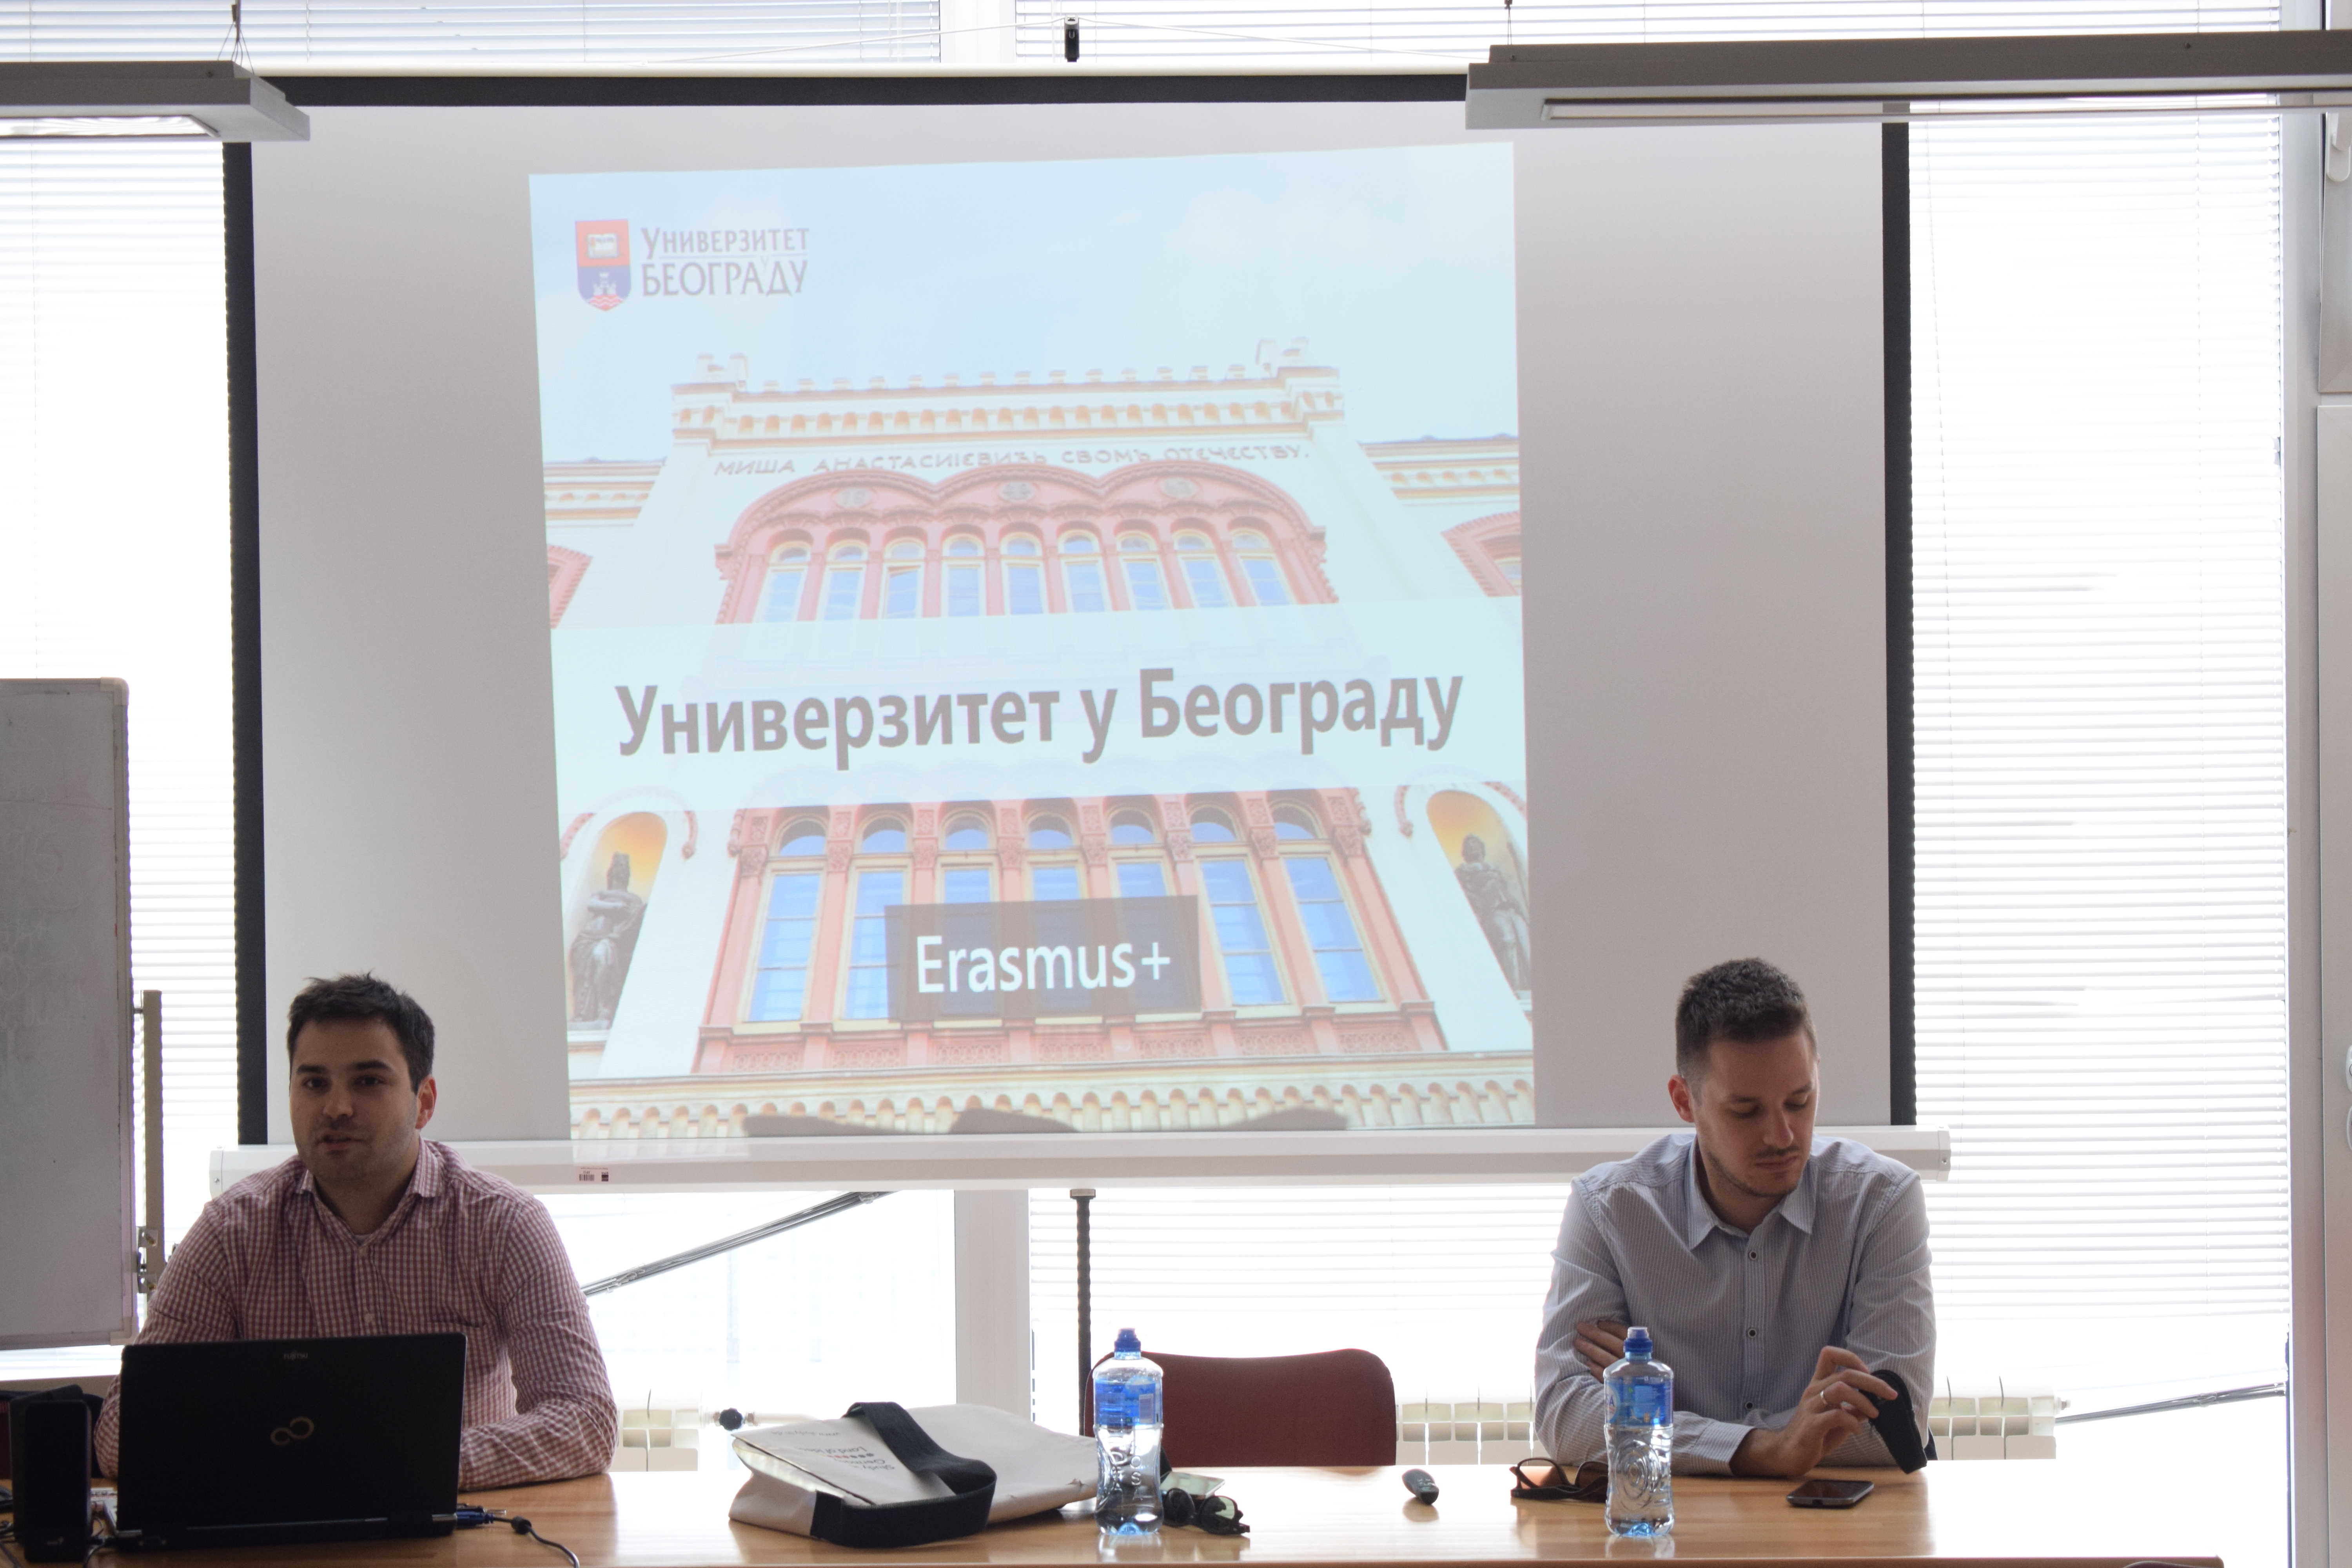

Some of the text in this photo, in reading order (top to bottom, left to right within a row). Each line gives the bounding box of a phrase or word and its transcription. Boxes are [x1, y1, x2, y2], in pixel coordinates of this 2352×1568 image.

[641, 227, 809, 260] УНИВЕРЗИТЕТ
[641, 260, 808, 296] БЕОГРАДУ
[714, 460, 795, 475] МИША
[615, 667, 1465, 771] Универзитет у Београду
[916, 935, 1171, 993] Erasmus+
